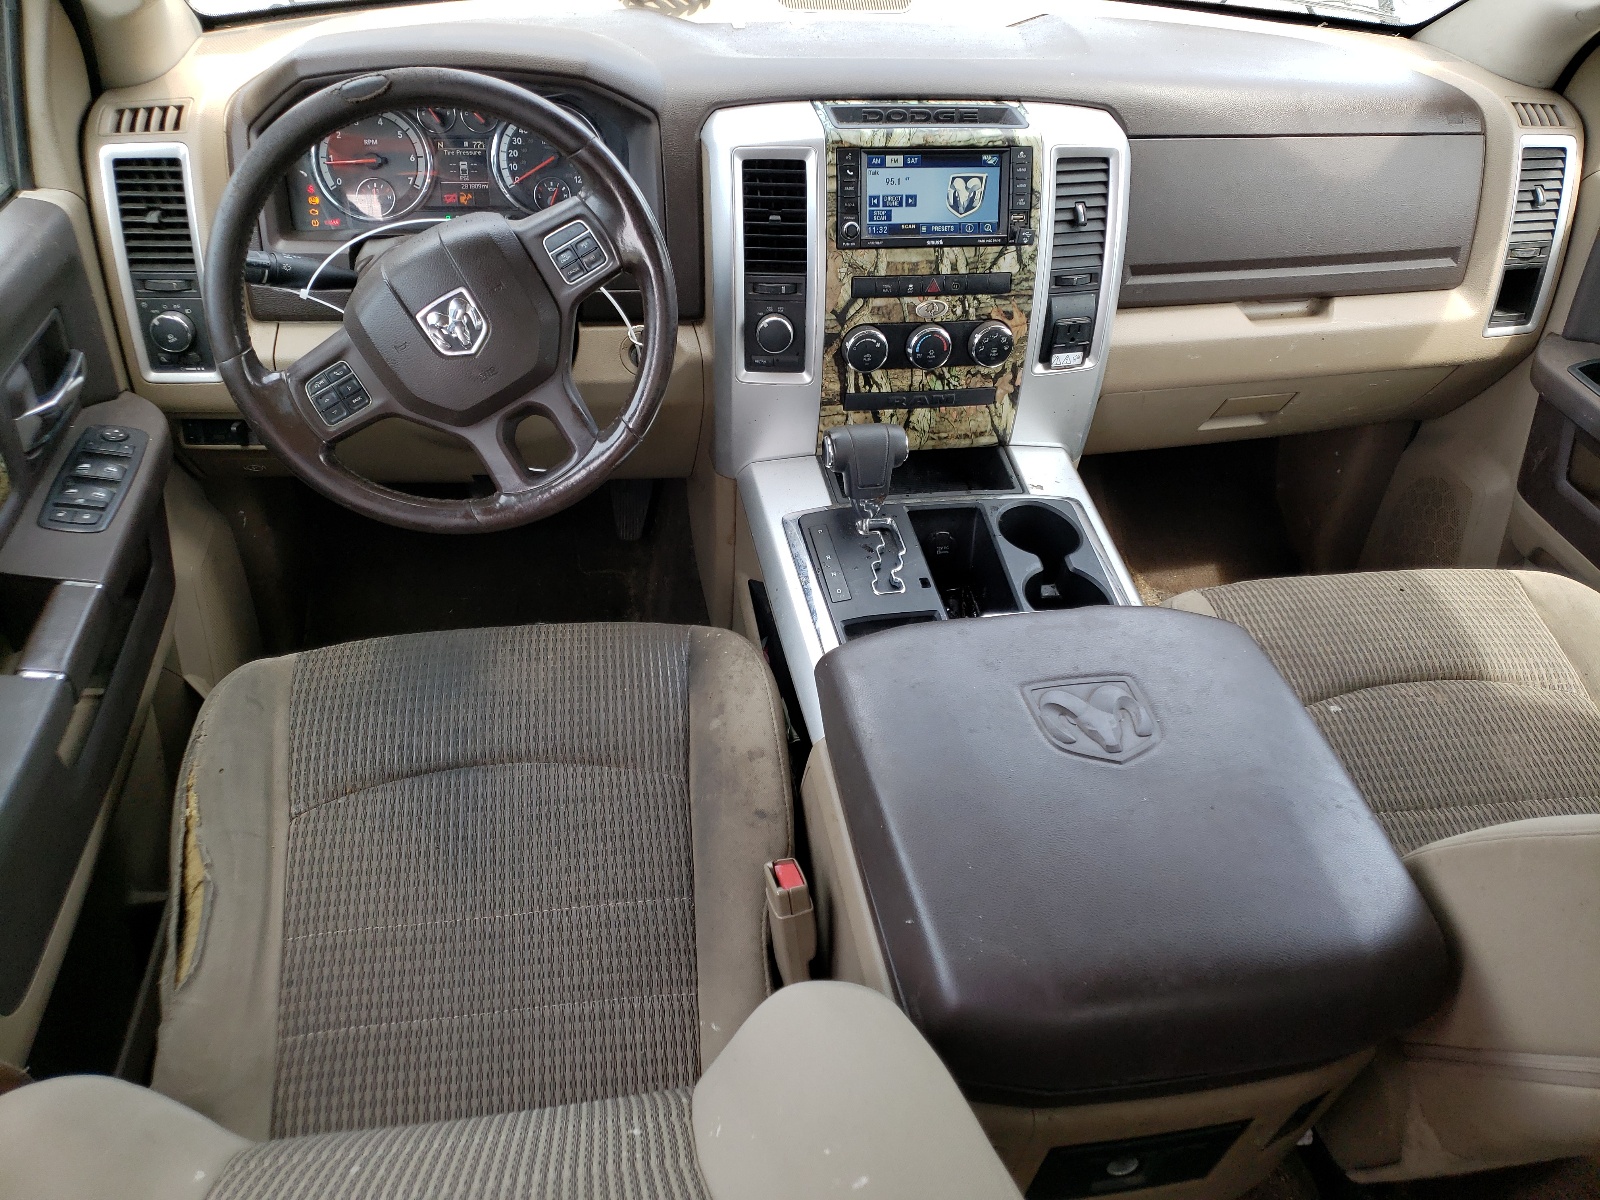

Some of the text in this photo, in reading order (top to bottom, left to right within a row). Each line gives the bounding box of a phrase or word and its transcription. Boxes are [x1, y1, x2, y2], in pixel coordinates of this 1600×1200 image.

[861, 108, 979, 123] DODGE
[377, 117, 383, 126] 4
[336, 131, 342, 139] 2
[397, 130, 403, 139] 5
[512, 137, 522, 145] 30
[508, 150, 519, 158] 20
[336, 177, 342, 185] 0
[408, 177, 414, 185] 7
[885, 177, 901, 186] 95.1
[868, 226, 888, 234] 11:32
